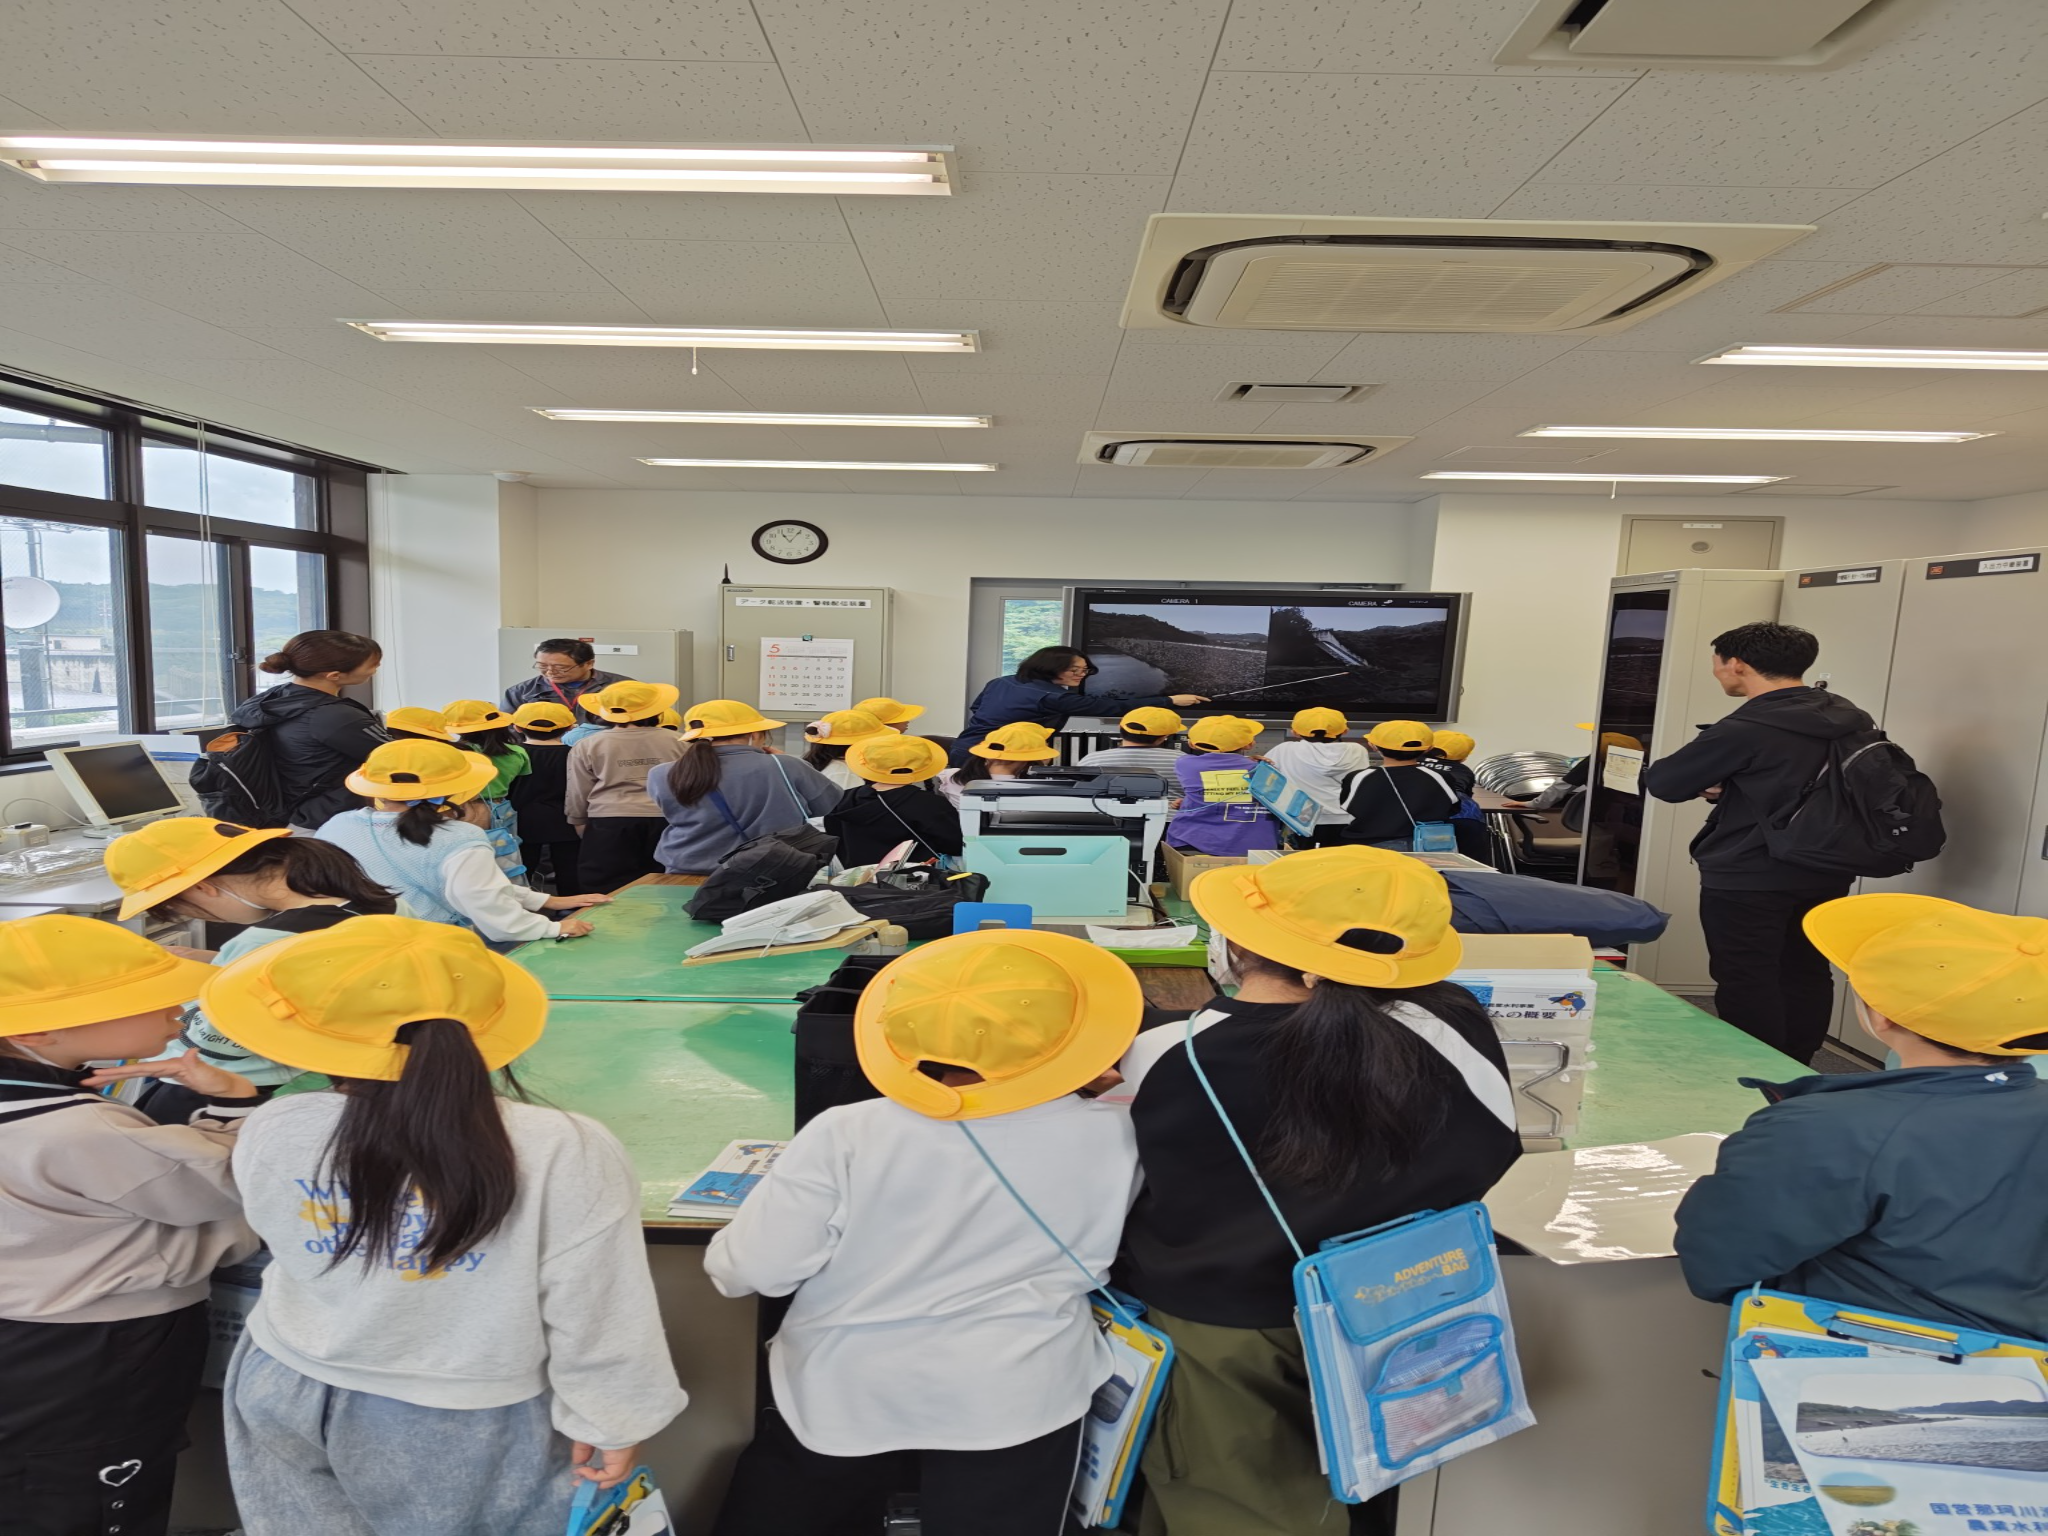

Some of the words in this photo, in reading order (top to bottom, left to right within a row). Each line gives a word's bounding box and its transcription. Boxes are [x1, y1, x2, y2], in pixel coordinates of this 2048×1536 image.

[769, 643, 780, 654] 5
[1394, 1248, 1466, 1283] ADVENTURE
[1442, 1260, 1470, 1276] BAG
